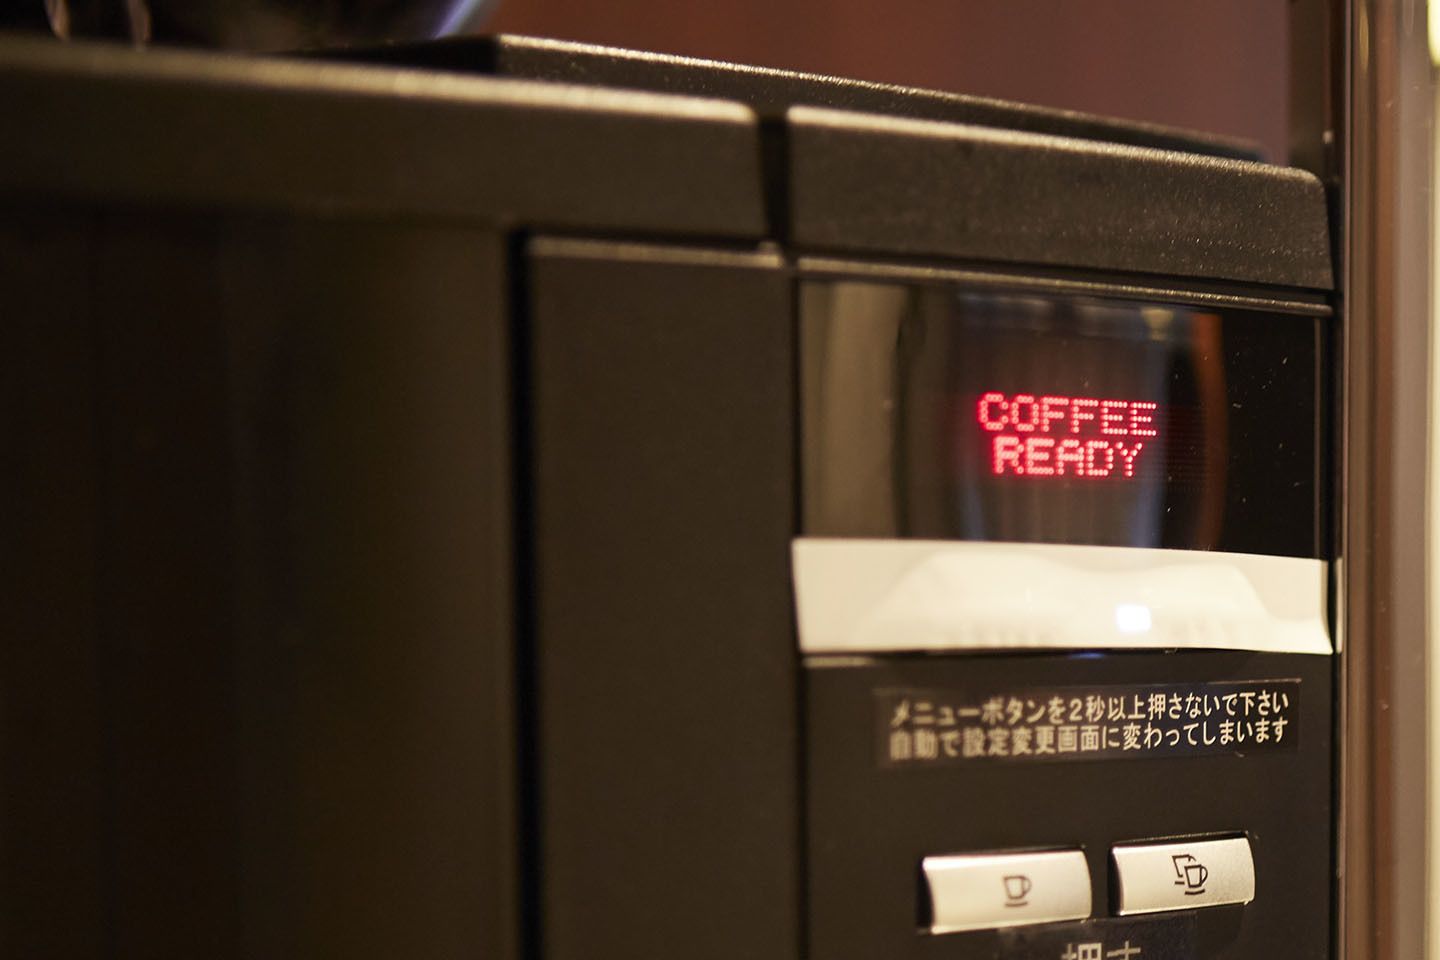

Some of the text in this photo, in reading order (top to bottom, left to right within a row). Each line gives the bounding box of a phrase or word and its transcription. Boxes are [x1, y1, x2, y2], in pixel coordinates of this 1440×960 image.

[978, 392, 1157, 437] COFFEE
[994, 436, 1143, 477] READY
[890, 717, 1289, 760] 自動で設定変更画面に変わってしまいます
